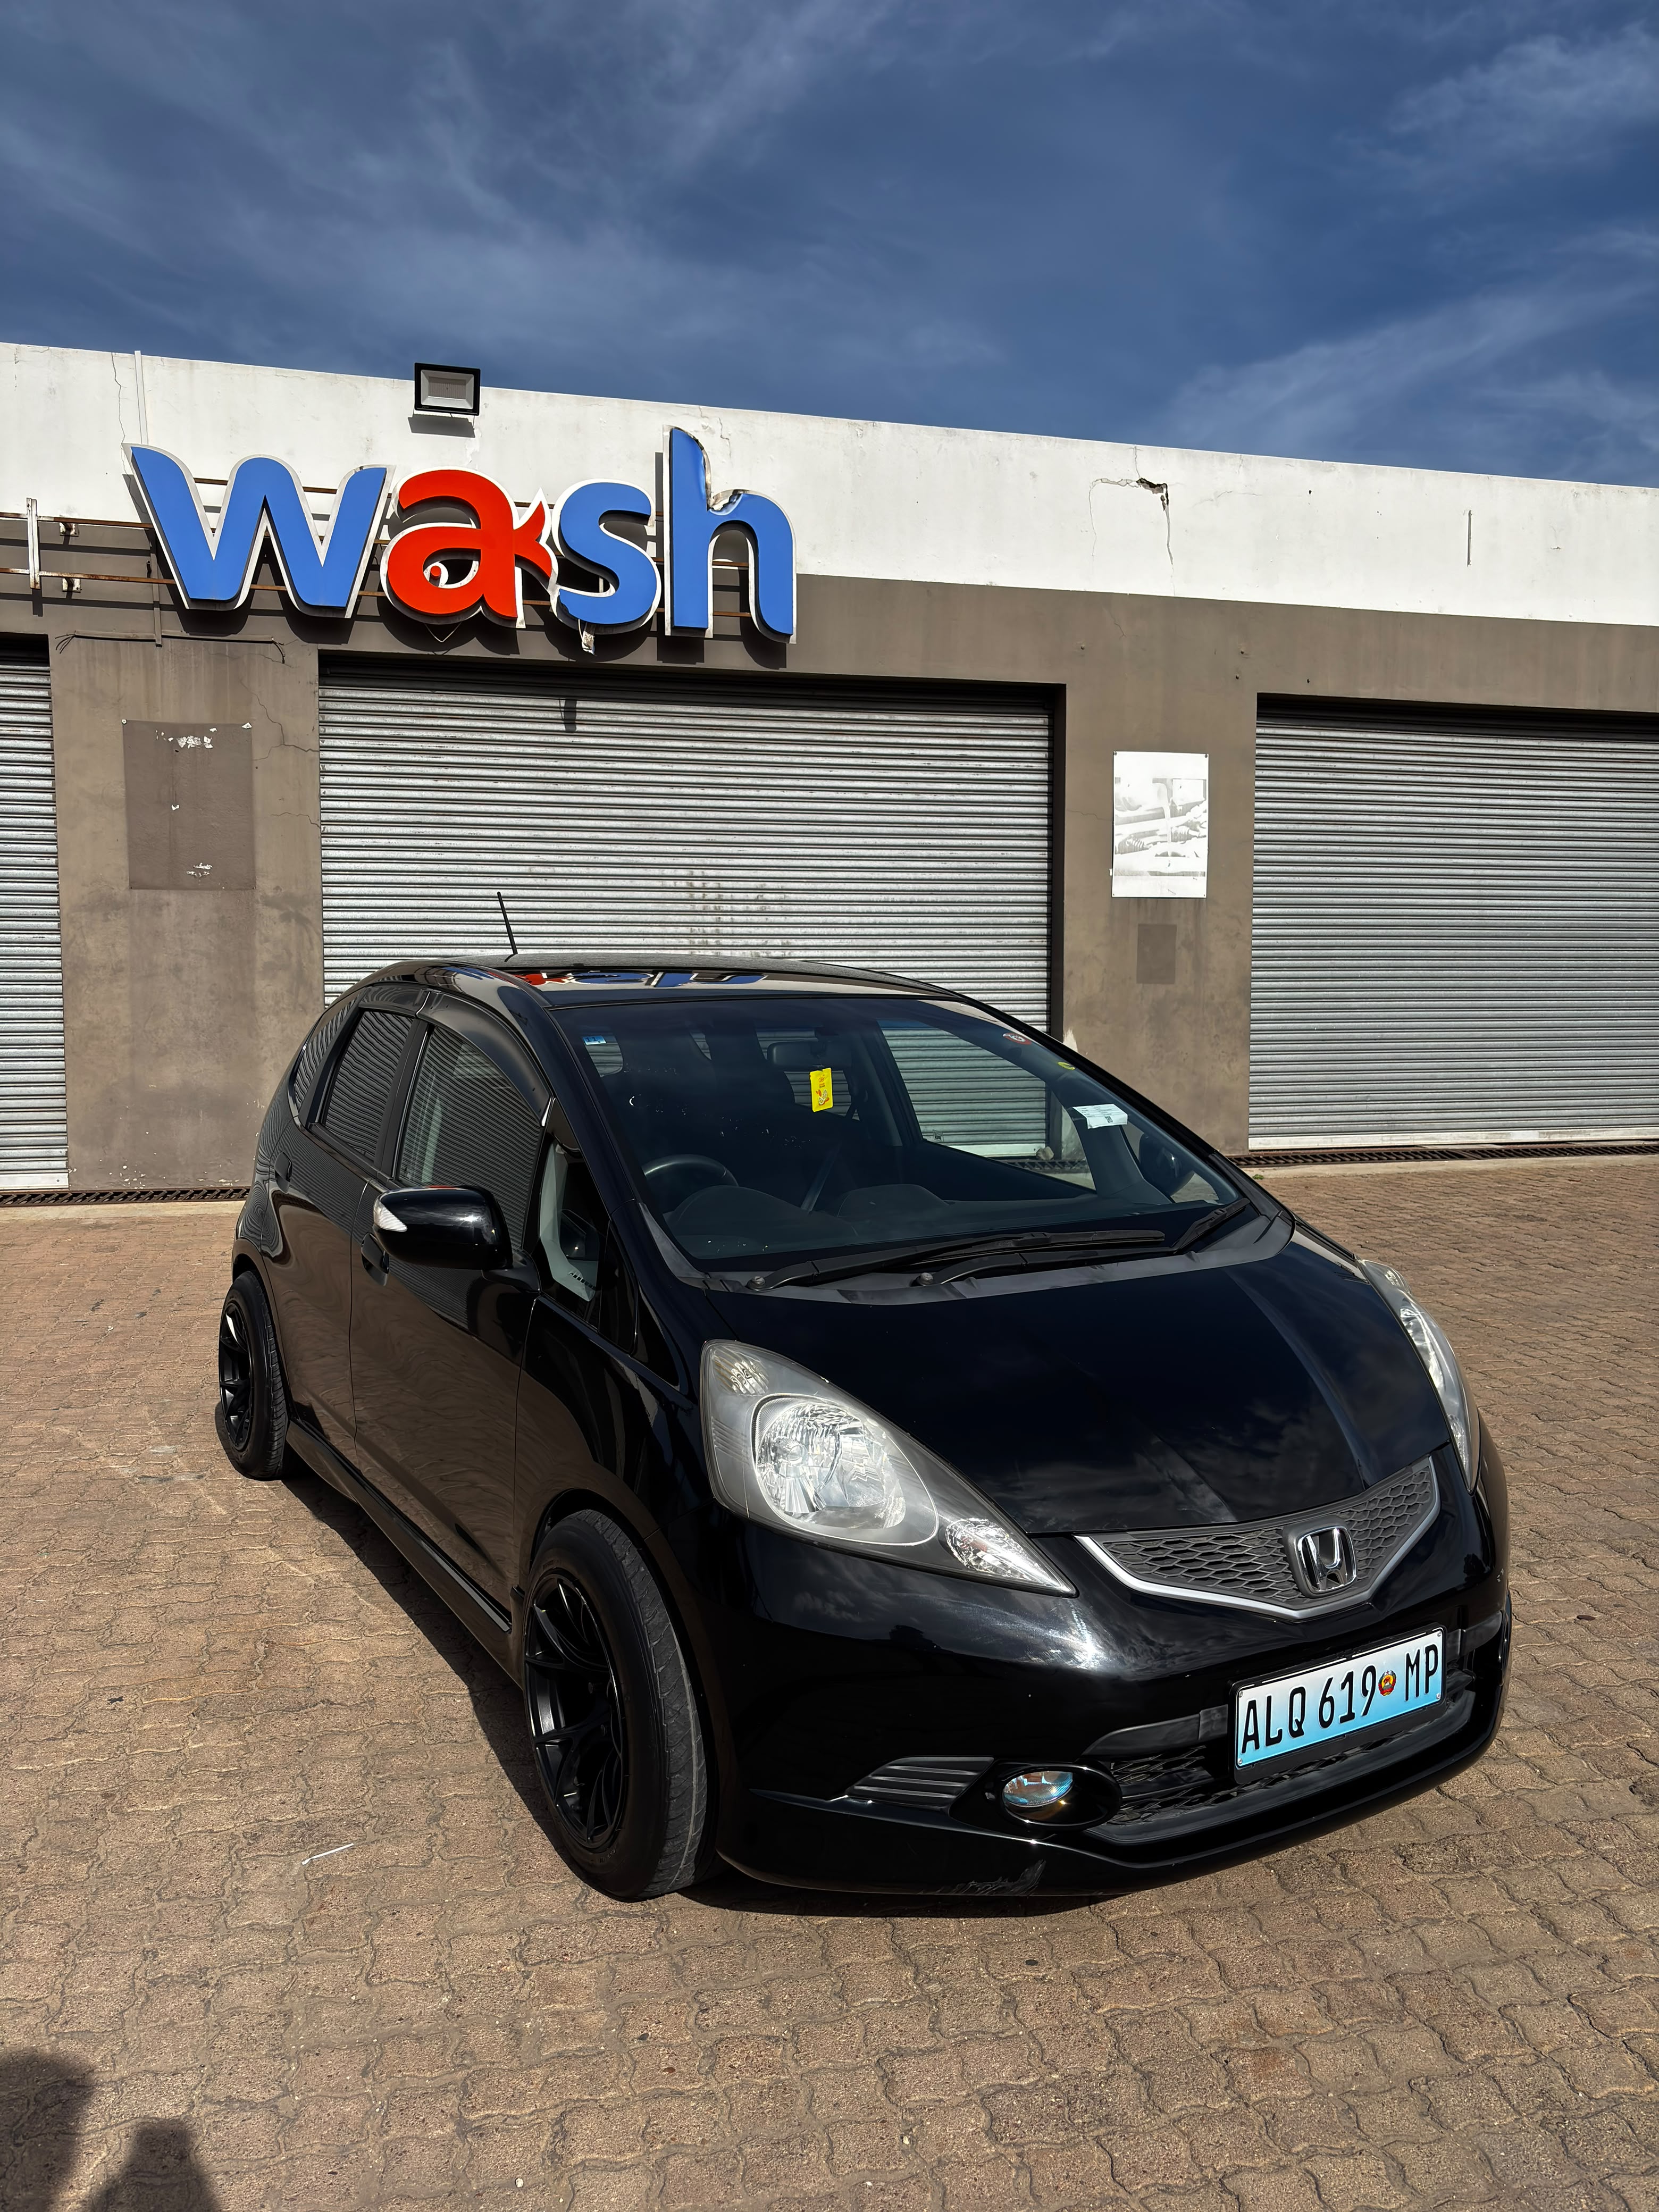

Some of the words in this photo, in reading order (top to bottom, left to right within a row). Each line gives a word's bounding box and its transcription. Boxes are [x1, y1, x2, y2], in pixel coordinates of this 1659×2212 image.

[124, 426, 797, 644] wash
[1241, 1687, 1305, 1754] ALQ
[1318, 1665, 1376, 1728] 619
[1404, 1644, 1438, 1702] MP
